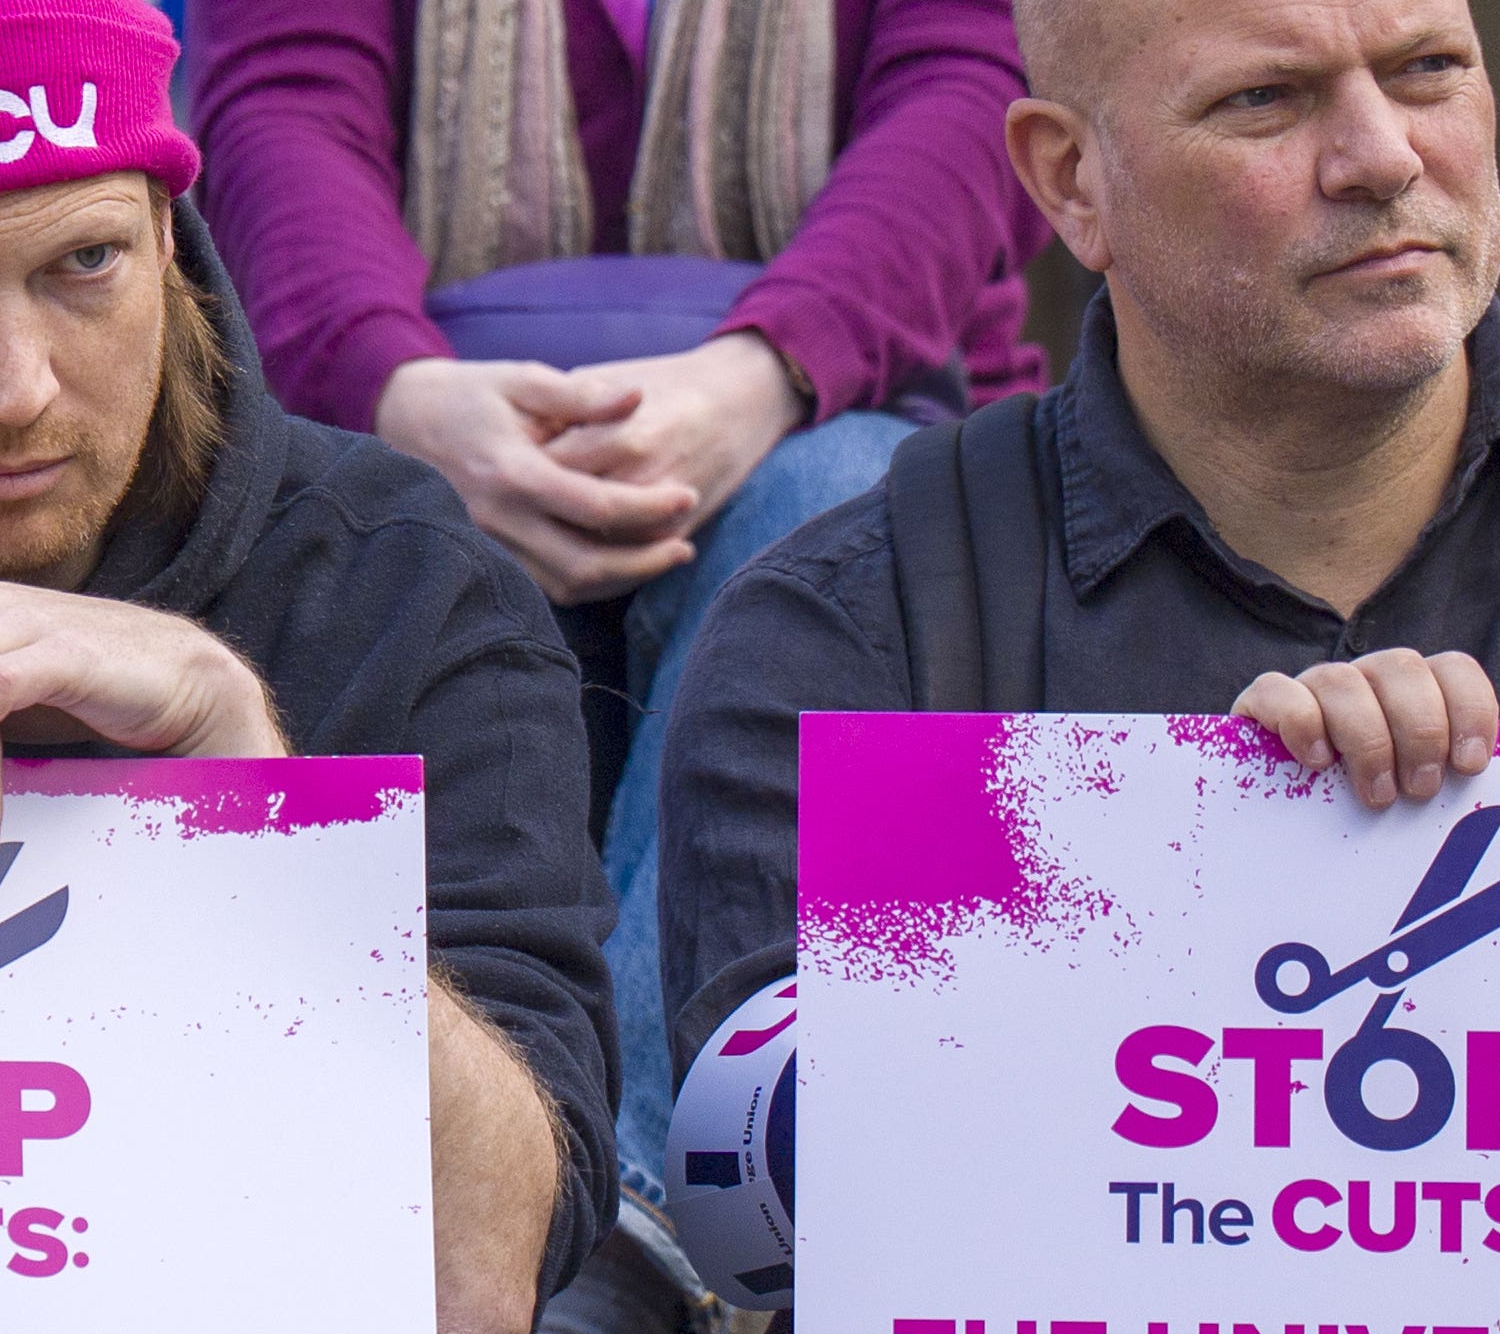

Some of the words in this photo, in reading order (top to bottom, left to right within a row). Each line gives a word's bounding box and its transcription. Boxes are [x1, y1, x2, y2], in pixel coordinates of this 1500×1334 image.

[742, 1086, 762, 1146] Union
[759, 1202, 793, 1255] Union
[1109, 1180, 1254, 1246] The
